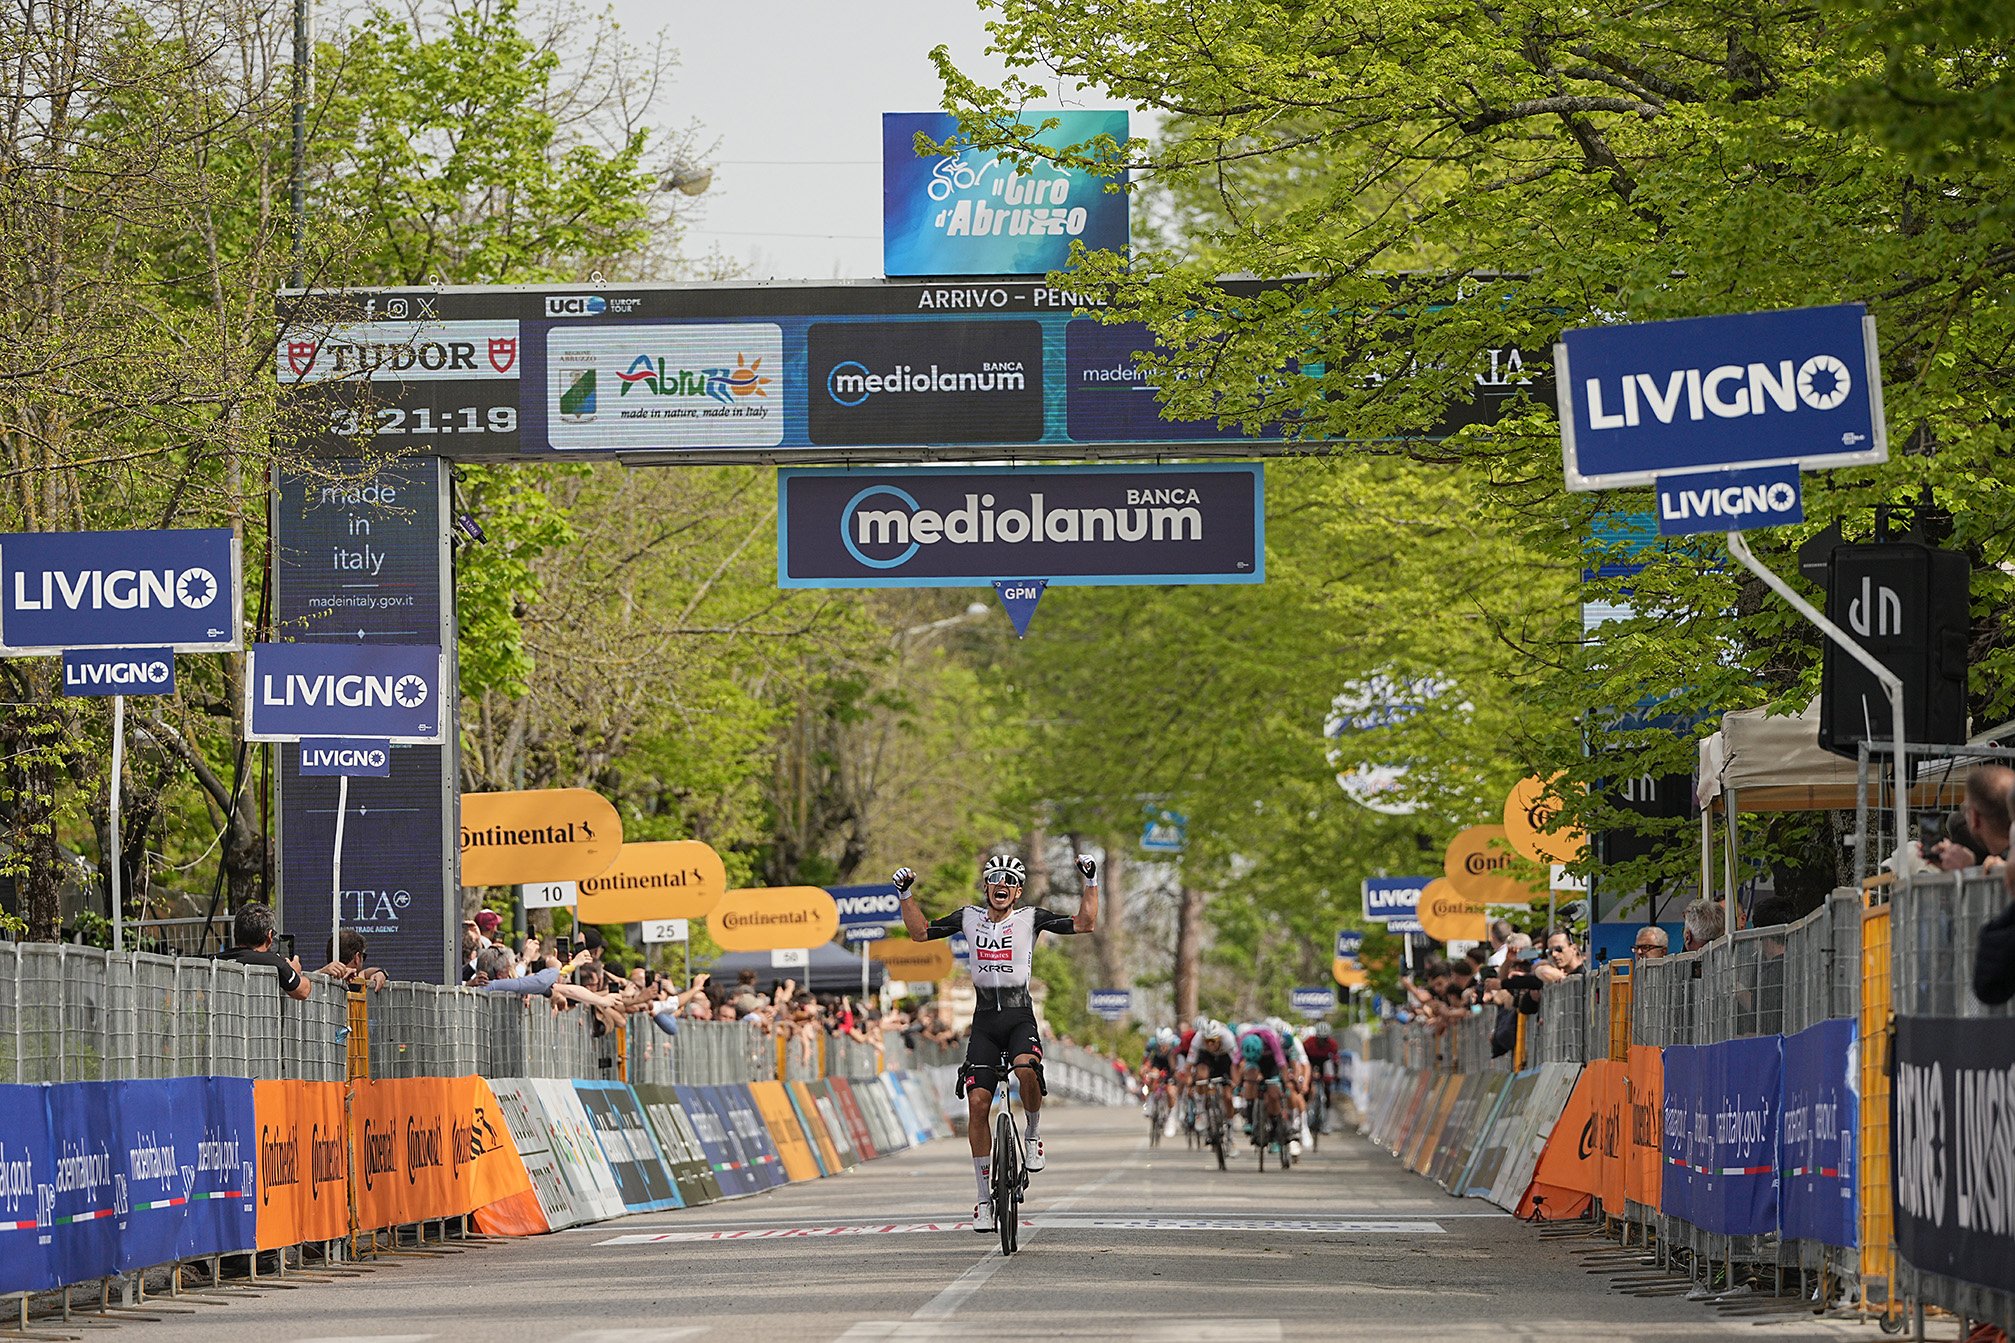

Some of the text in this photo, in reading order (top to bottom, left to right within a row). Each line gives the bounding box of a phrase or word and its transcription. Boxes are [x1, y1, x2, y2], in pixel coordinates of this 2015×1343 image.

[1004, 171, 1070, 206] Giro
[935, 199, 1088, 236] d'Abruzzo
[550, 299, 585, 314] UCI
[918, 289, 1008, 309] ARRIVO
[325, 342, 478, 372] TUDOR
[983, 362, 1024, 372] BANCA
[836, 365, 1025, 393] mediolanum
[1586, 354, 1852, 430] LIVIGNO
[620, 406, 768, 419] made in nature, made in Italy
[322, 475, 396, 504] made
[1126, 488, 1201, 505] BANCA
[1661, 481, 1796, 520] LIVIGNO
[349, 512, 370, 535] in
[857, 493, 1203, 545] mediolanum
[333, 544, 385, 576] italy
[14, 567, 218, 610] LIVIGNO
[1004, 587, 1037, 600] GPM
[309, 595, 413, 609] madeinitaly.gov.it
[66, 661, 169, 685] LIVIGNO
[263, 674, 428, 708] LIVIGNO
[302, 749, 386, 767] LIVIGNO
[579, 869, 687, 896] Continental
[541, 886, 562, 902] 10
[836, 894, 900, 915] IVIGNO
[355, 925, 374, 933] TRADE
[374, 925, 399, 933] AGENCY
[656, 925, 675, 938] 25
[723, 911, 808, 930] Continental
[976, 935, 1013, 949] UAE
[978, 965, 1014, 973] XRG
[56, 1138, 111, 1203] adeinitaly.gov.it
